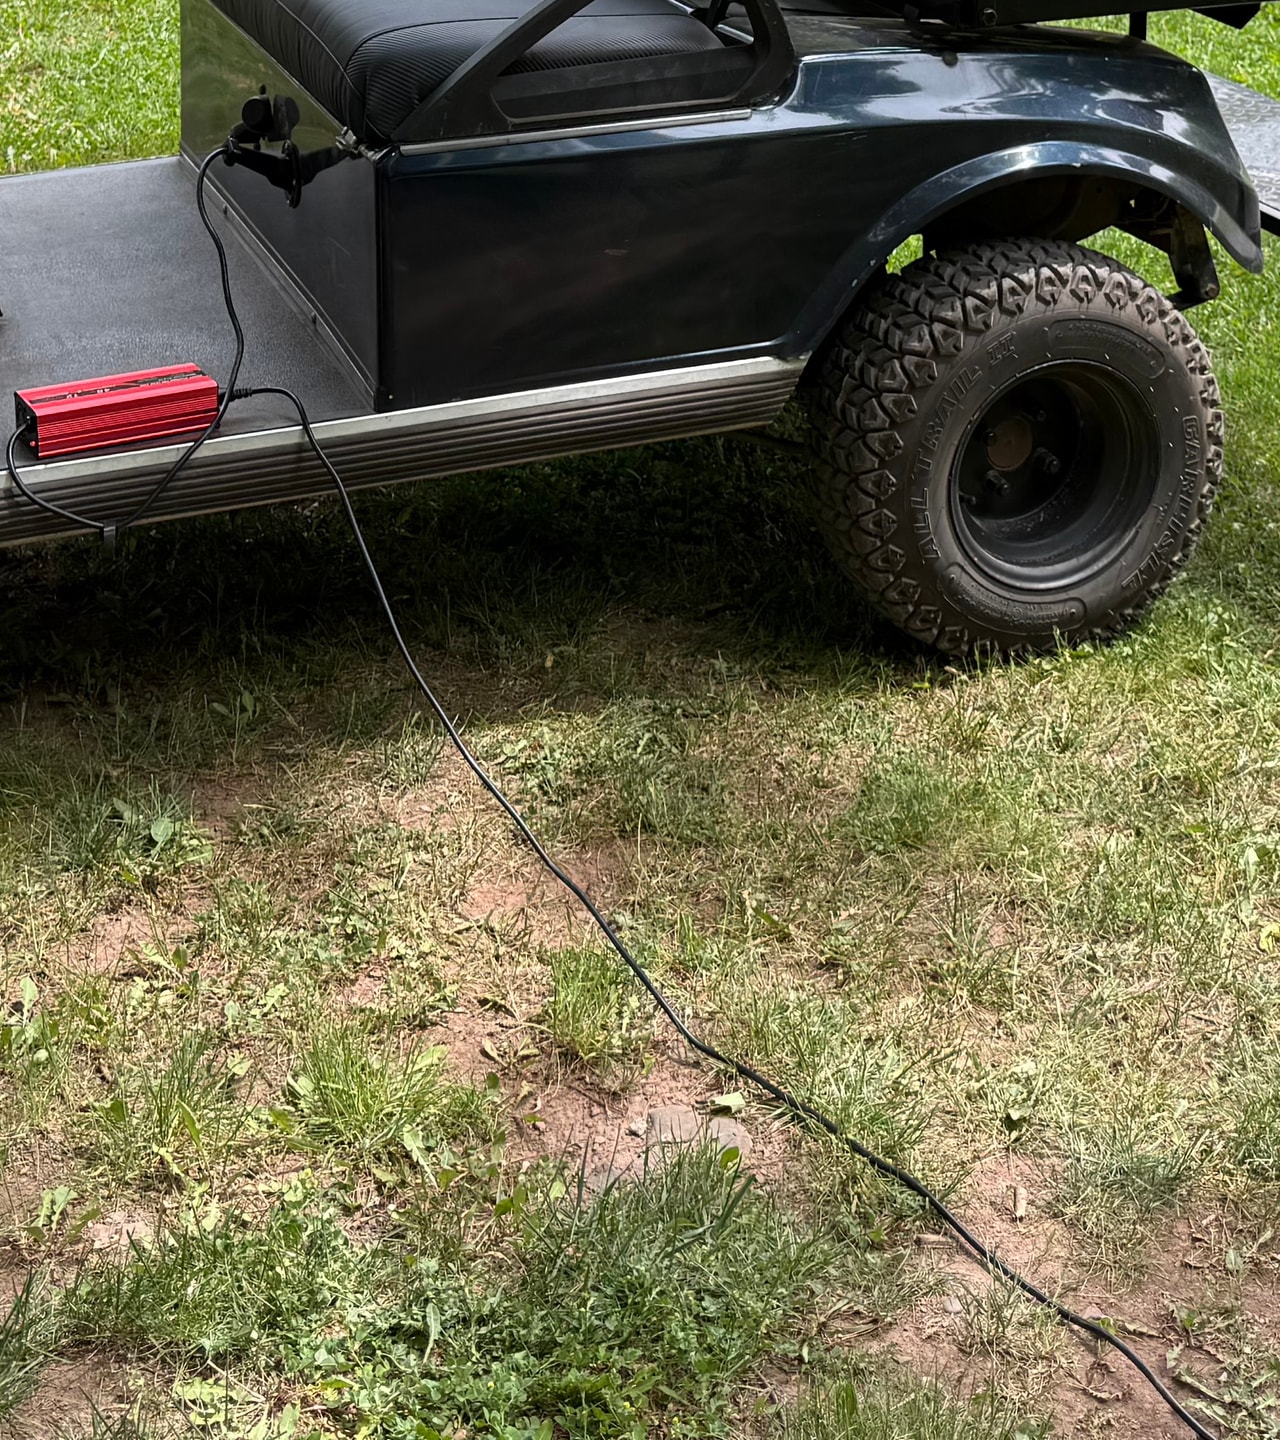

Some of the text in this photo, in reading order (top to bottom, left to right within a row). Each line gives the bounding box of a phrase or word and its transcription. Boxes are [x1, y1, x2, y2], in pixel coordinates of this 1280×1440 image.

[910, 330, 1017, 561] ALL TRAIL II
[1121, 415, 1200, 590] CARLISLE
